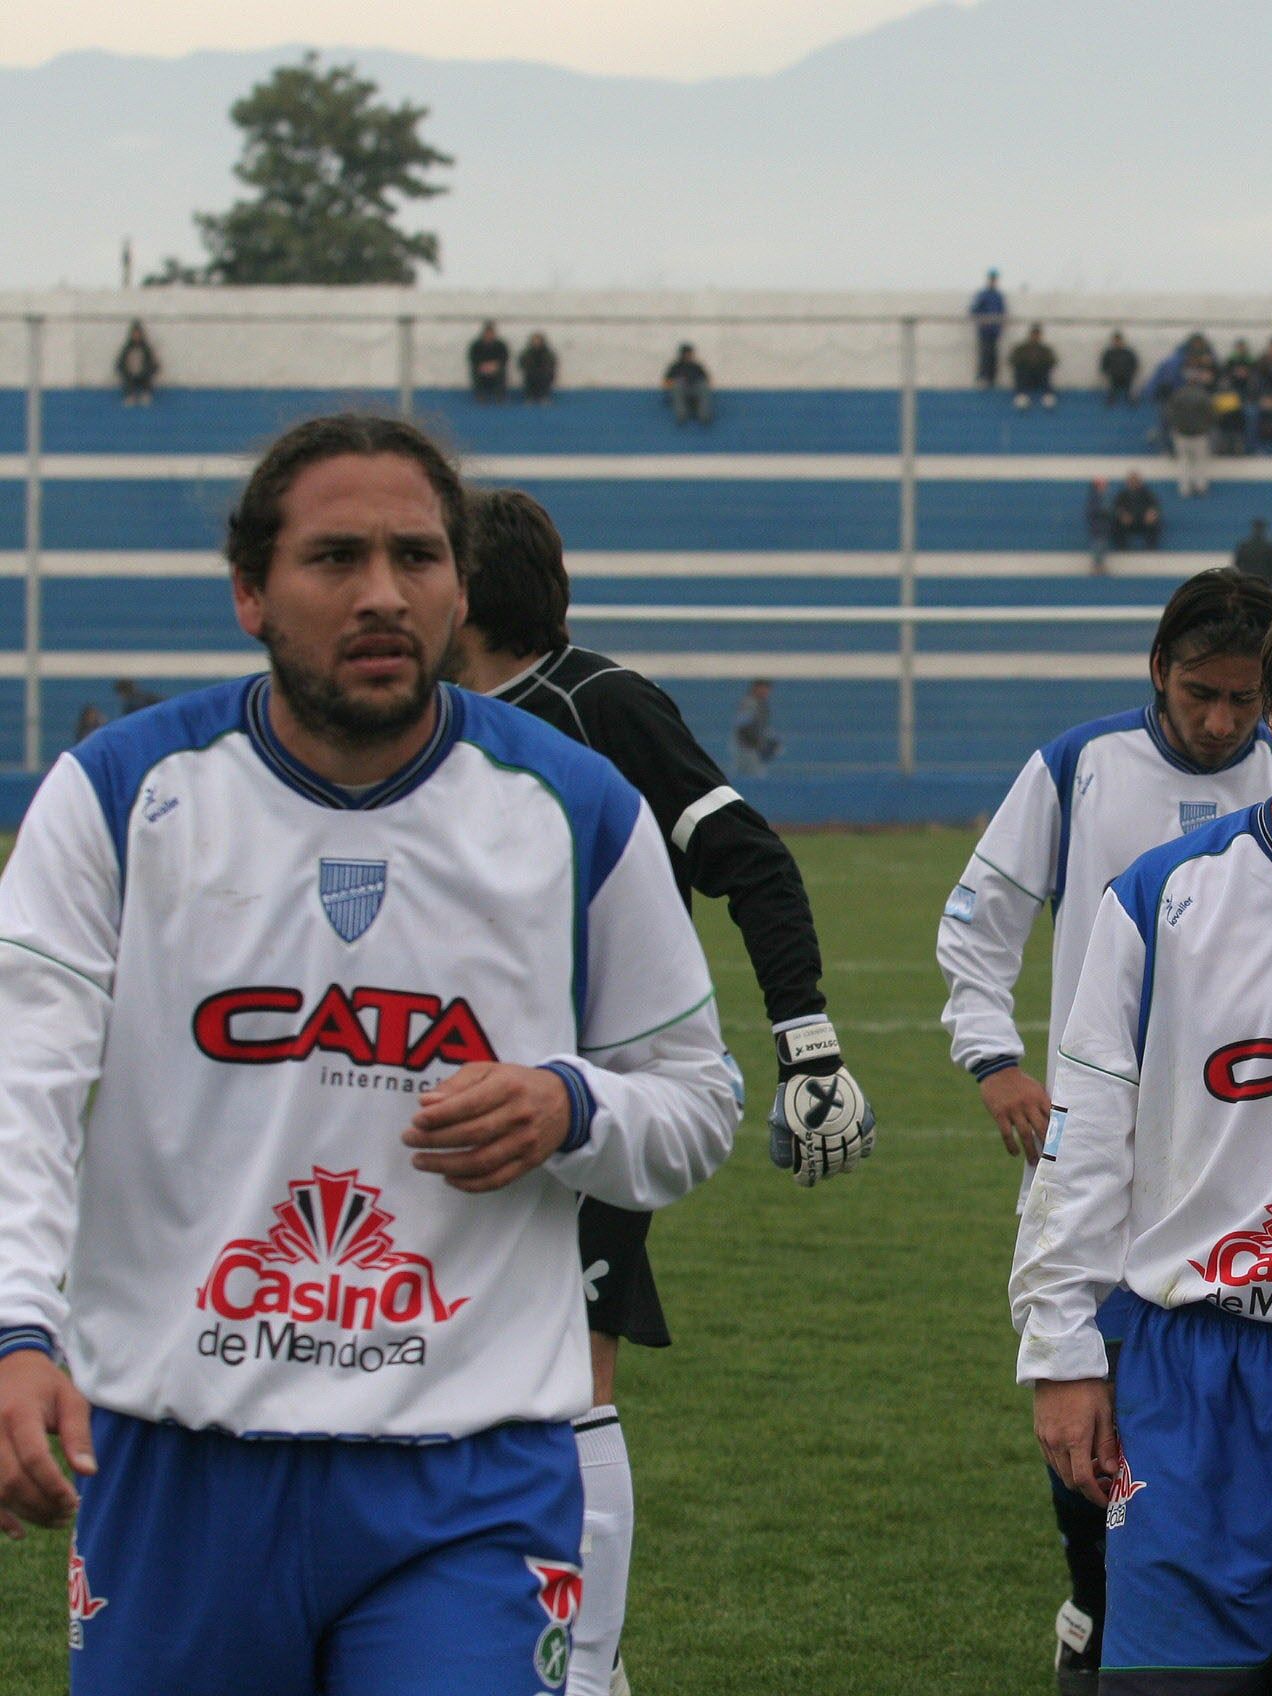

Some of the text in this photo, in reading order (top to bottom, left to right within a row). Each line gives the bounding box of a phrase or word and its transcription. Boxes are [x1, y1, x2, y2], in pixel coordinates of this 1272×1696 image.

[192, 983, 500, 1072] CATA
[321, 1066, 441, 1093] internac
[1205, 1287, 1243, 1313] de
[198, 1320, 425, 1372] de Mendoza
